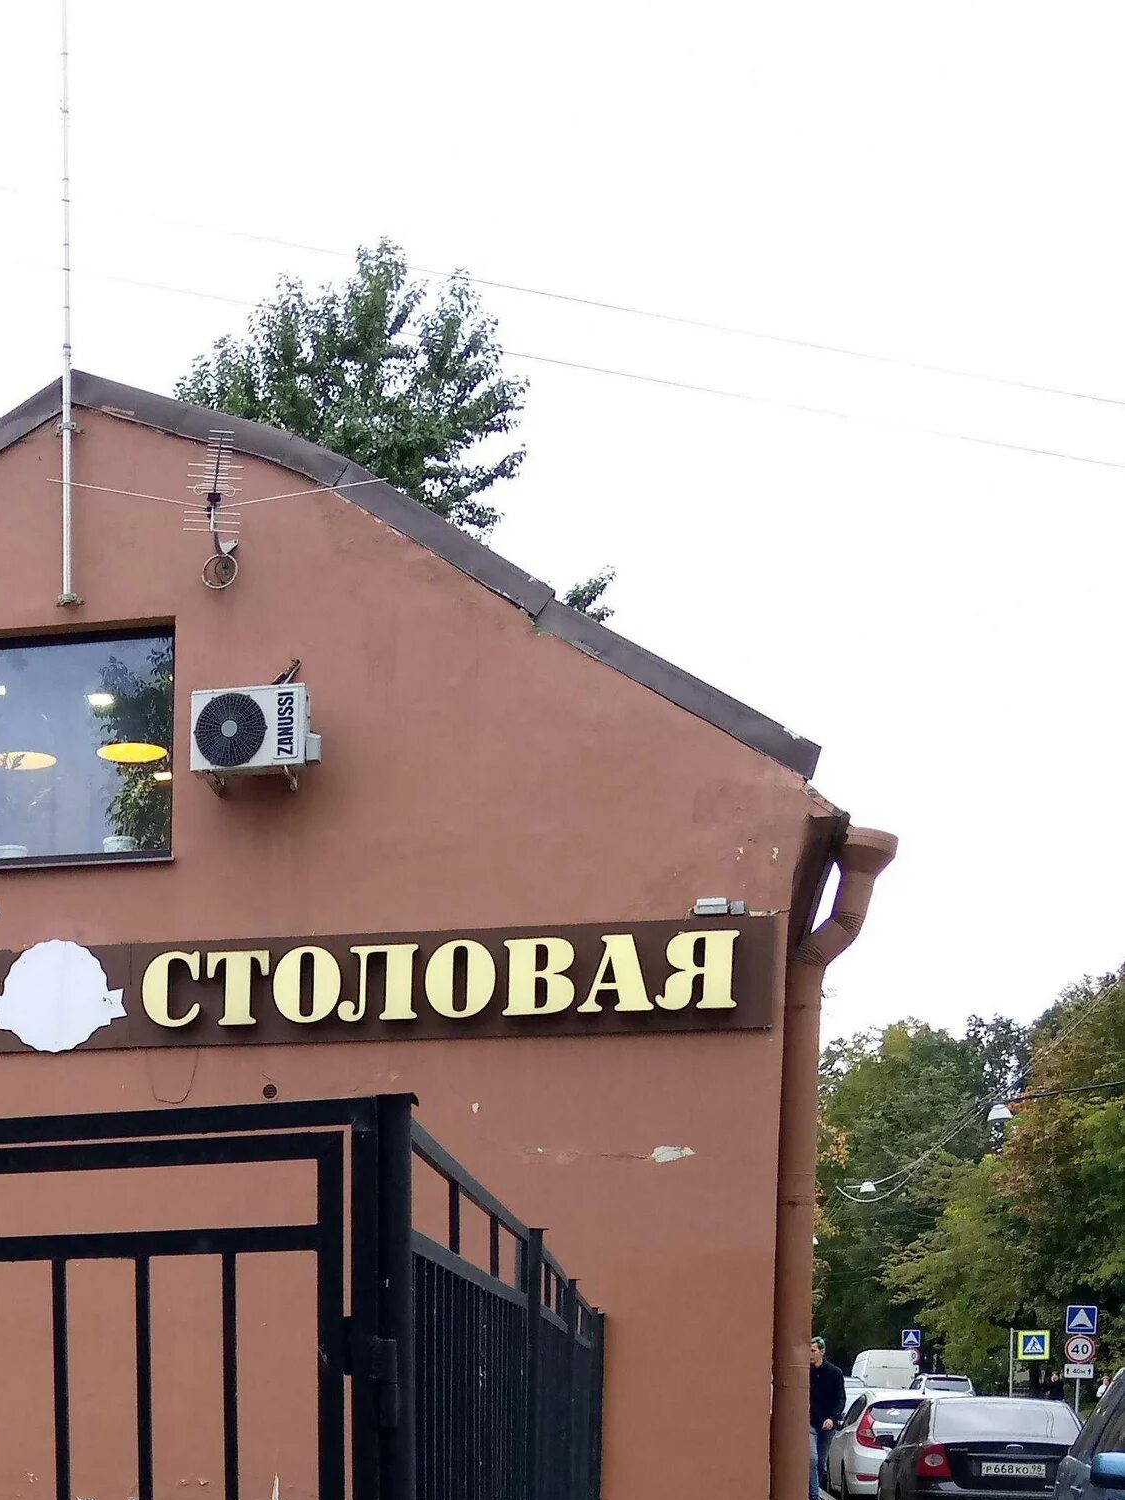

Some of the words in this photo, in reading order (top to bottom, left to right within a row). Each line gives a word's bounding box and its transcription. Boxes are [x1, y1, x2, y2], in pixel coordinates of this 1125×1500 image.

[277, 691, 294, 756] ZANUSSI
[140, 929, 741, 1028] СТОЛОВАЯ
[1071, 1344, 1089, 1354] 40
